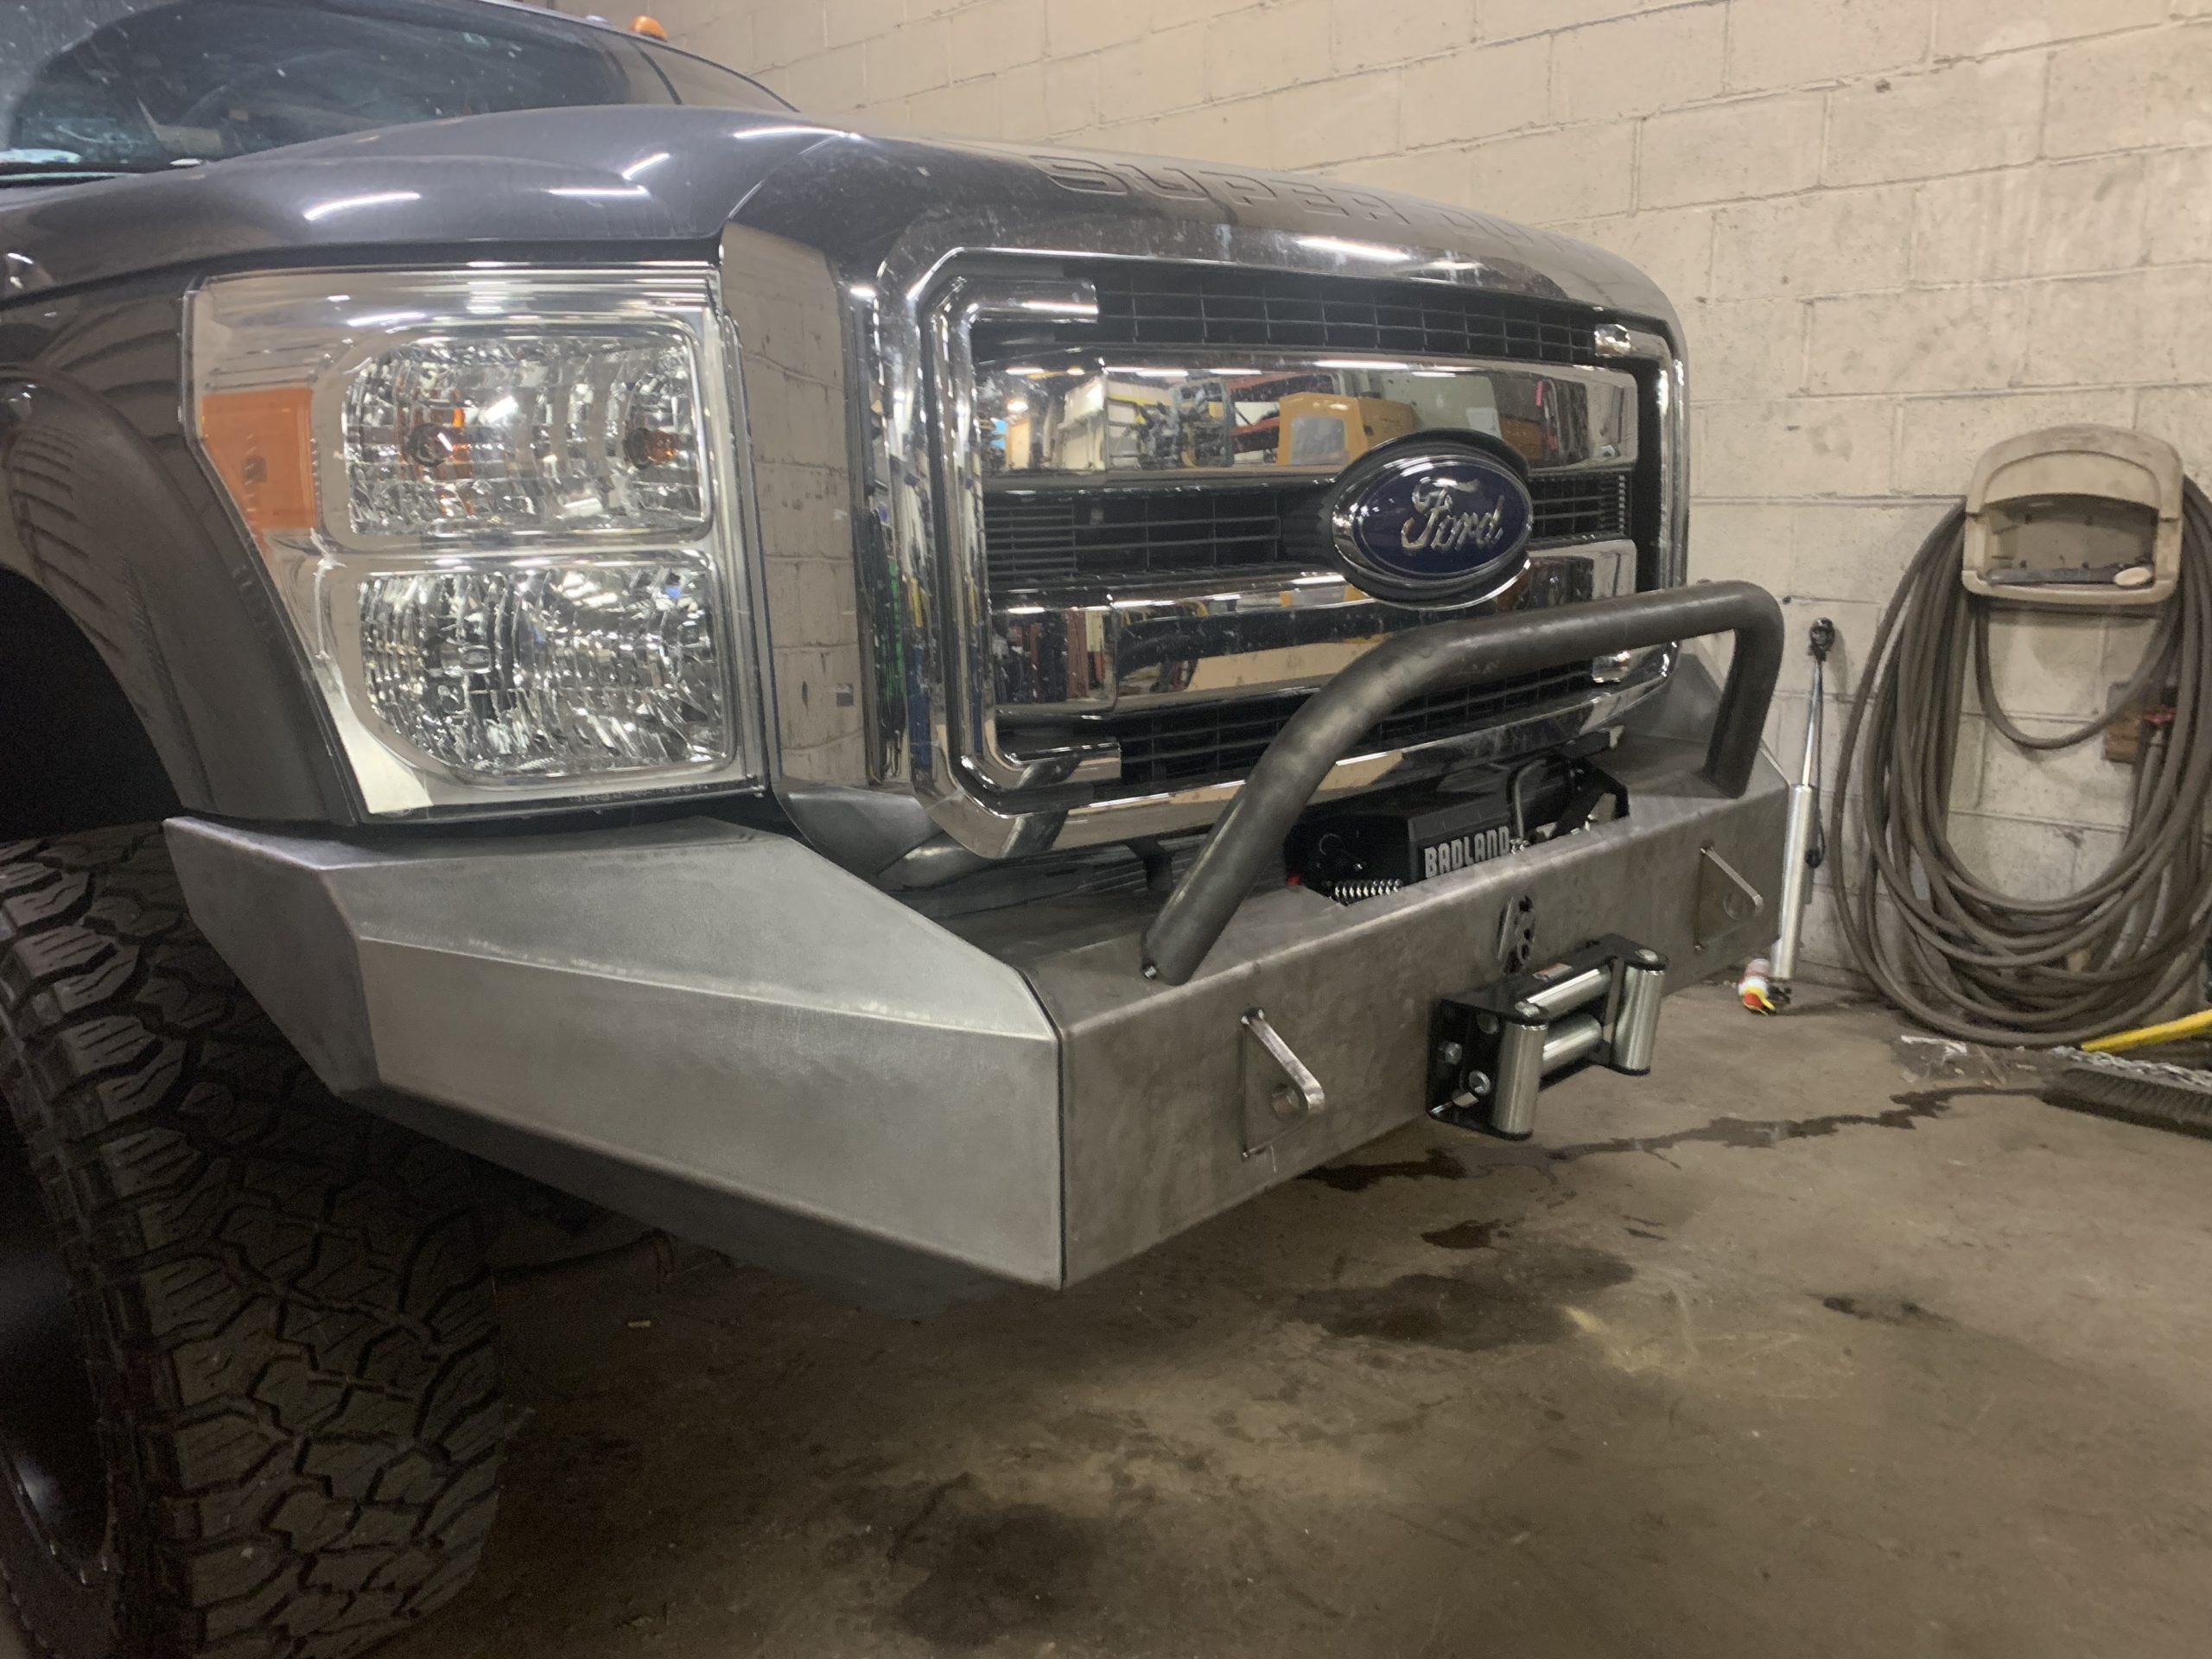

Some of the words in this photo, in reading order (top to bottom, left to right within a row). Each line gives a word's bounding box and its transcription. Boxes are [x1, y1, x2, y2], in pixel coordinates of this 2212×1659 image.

[1027, 154, 1410, 226] SUPER
[1400, 476, 1505, 550] Ford
[1424, 825, 1510, 879] BADLAND
